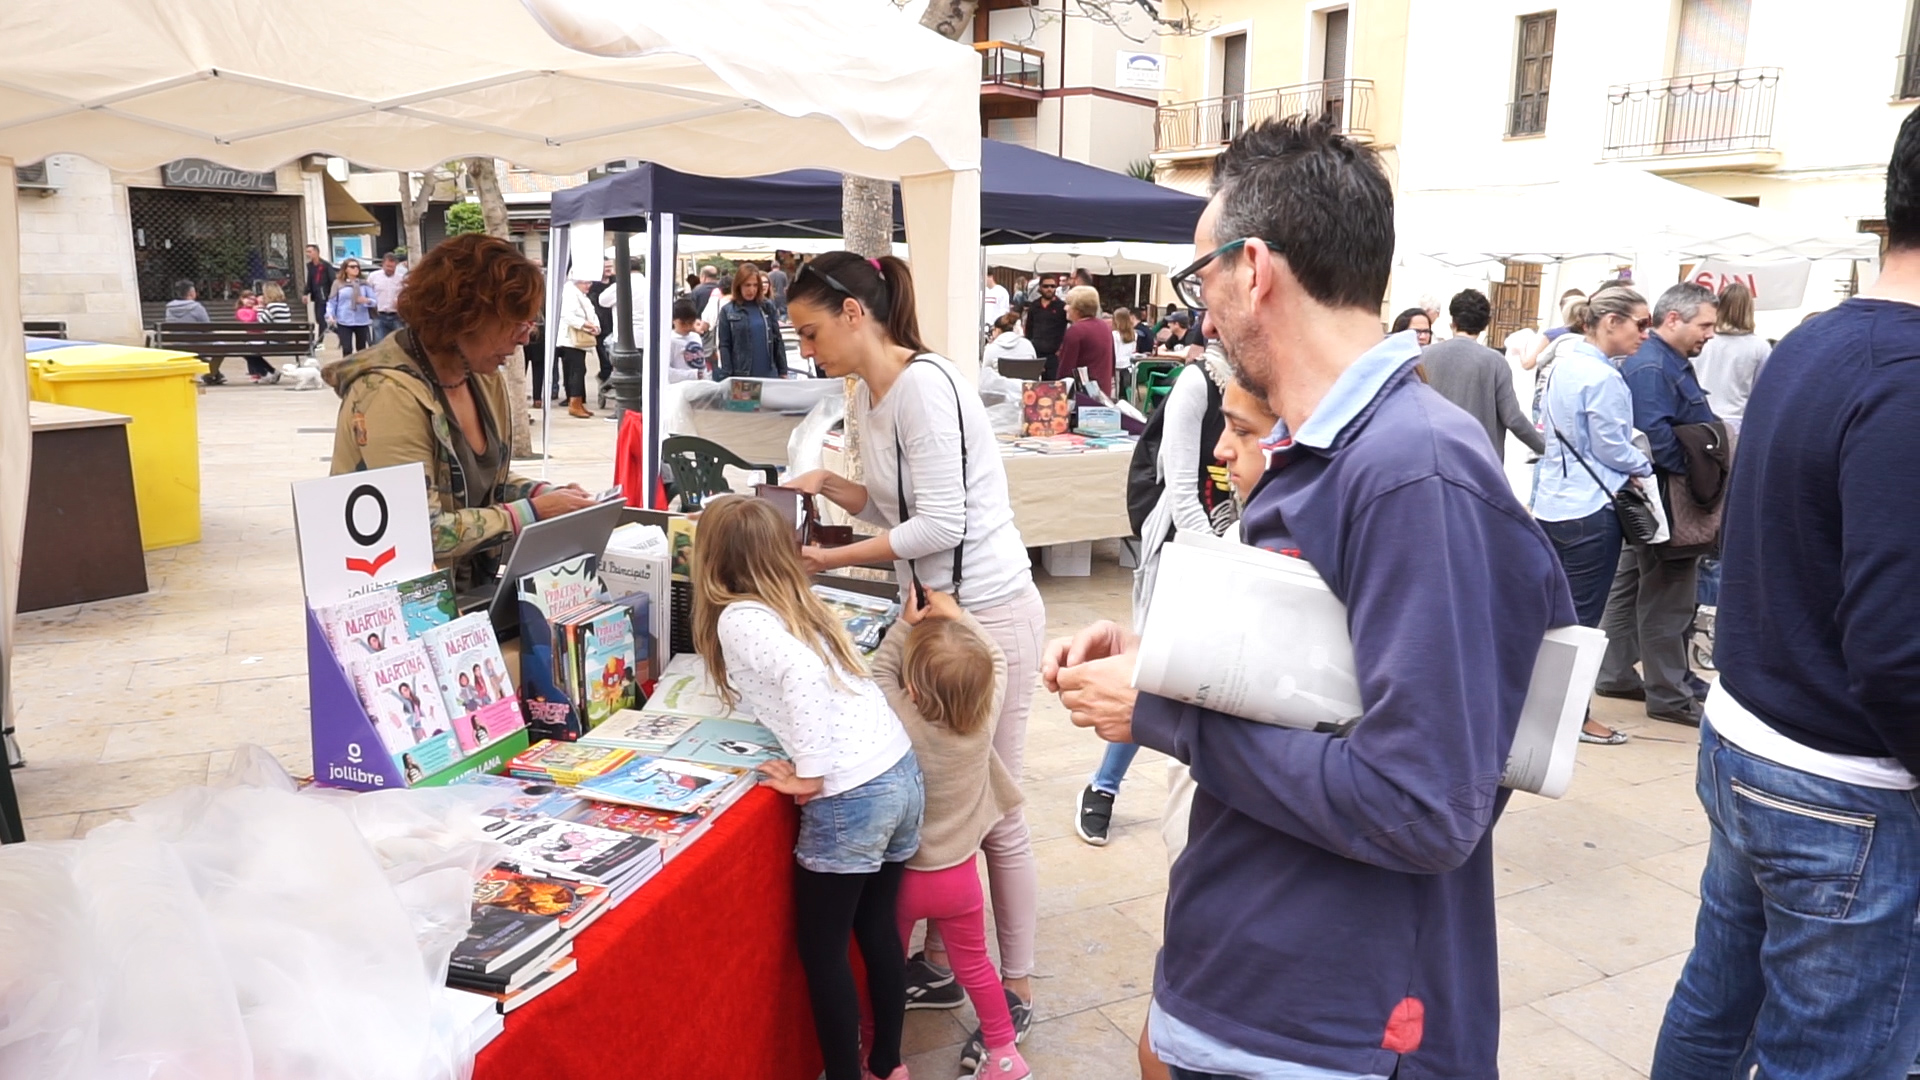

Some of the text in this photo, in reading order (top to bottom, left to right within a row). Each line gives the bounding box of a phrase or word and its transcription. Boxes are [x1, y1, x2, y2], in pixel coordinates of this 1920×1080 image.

[609, 561, 651, 581] Principito
[345, 606, 397, 636] MARTINA
[445, 627, 491, 657] MARTINA
[374, 655, 425, 687] MARTINA
[329, 763, 384, 786] jollibre
